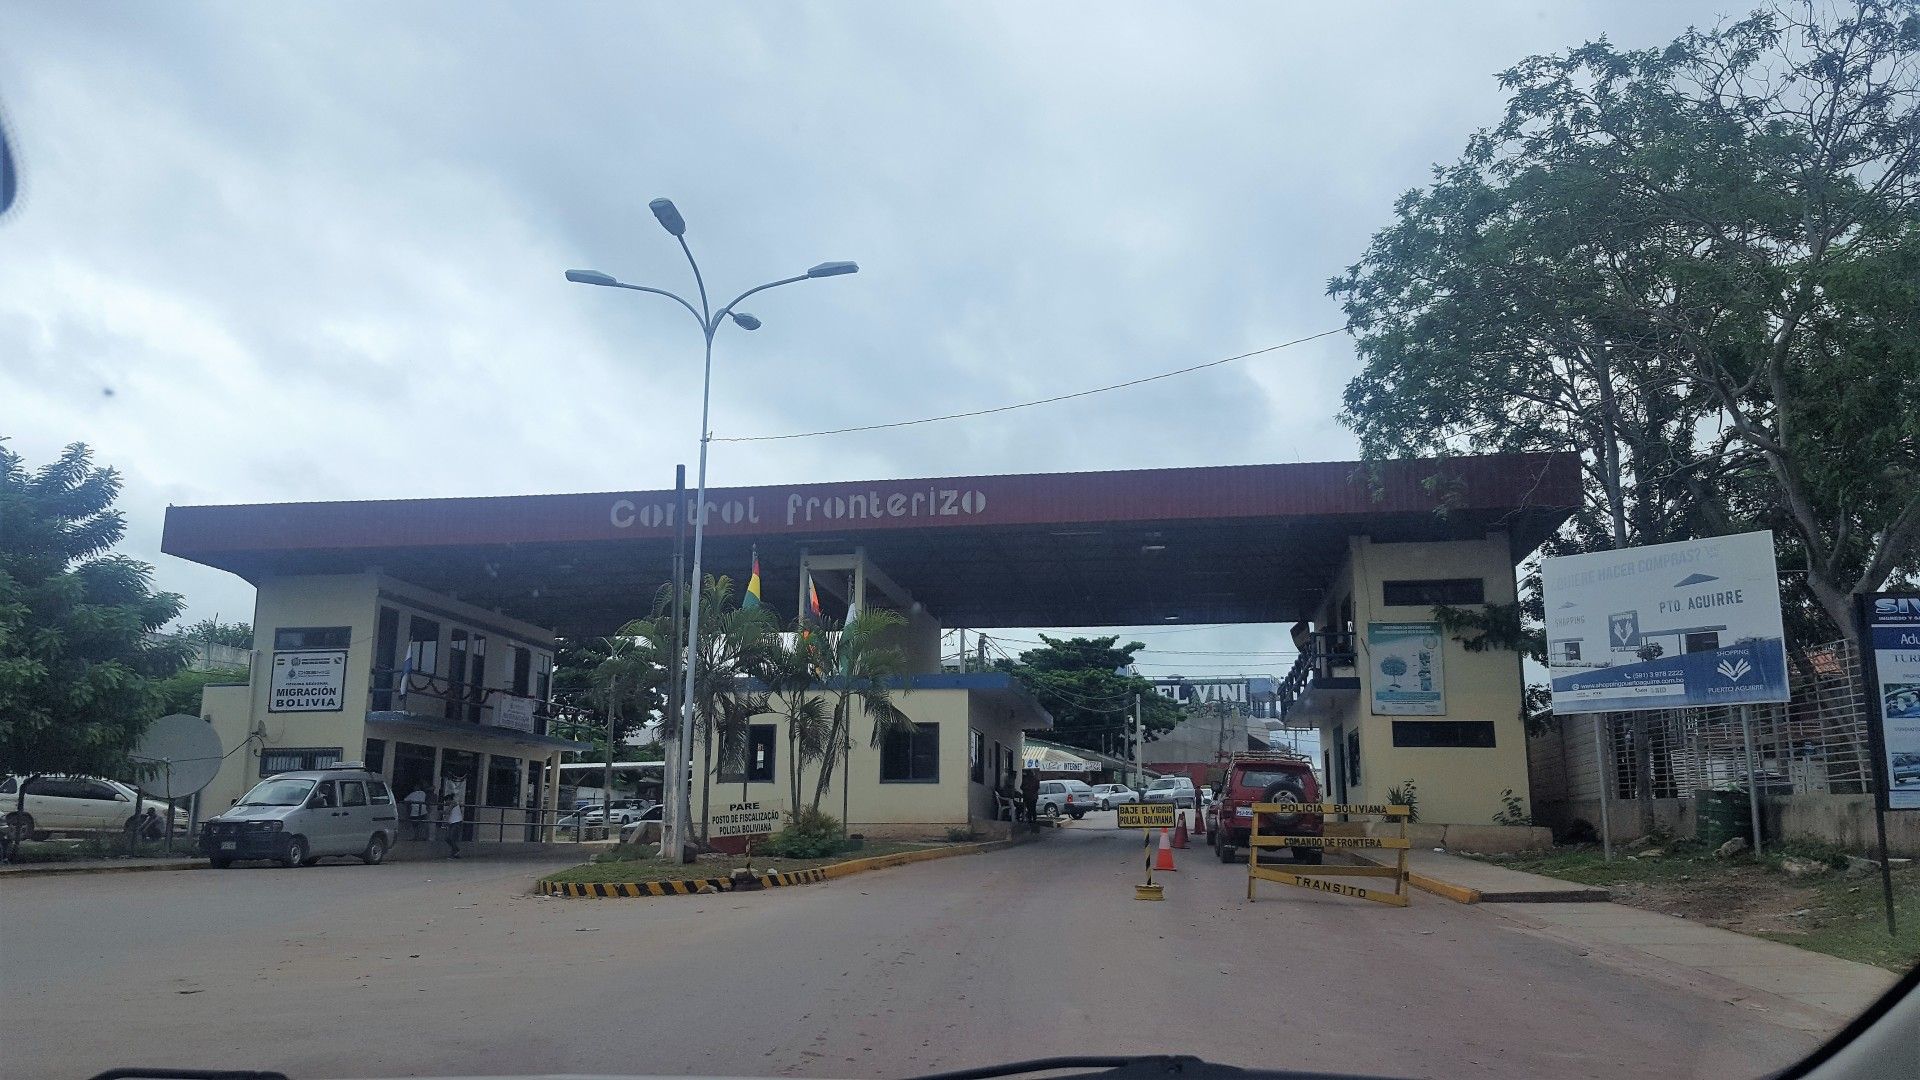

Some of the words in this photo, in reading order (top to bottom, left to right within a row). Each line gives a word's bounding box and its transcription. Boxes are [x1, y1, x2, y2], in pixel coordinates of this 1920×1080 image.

[786, 487, 987, 526] fronterizo
[1597, 562, 1635, 581] HACER
[1638, 547, 1701, 575] COMPRAS?
[1688, 589, 1744, 610] AGUIRRE
[276, 685, 337, 697] MIGRACIÓN
[1708, 686, 1734, 694] PUERTO
[1734, 684, 1764, 692] AGUIRRE
[276, 698, 336, 707] BOLIVIA
[1063, 763, 1083, 771] INTERNET
[729, 802, 760, 811] PARE
[1120, 806, 1139, 814] BAJE
[1141, 806, 1150, 814] EL
[1150, 806, 1173, 814] VIDRIO
[1280, 804, 1324, 813] POLICIA
[1333, 804, 1388, 814] BOLIVIANA
[712, 815, 730, 824] POSTO
[731, 814, 739, 823] DE
[740, 810, 779, 822] FISCALIZAÇÃO
[1120, 816, 1141, 824] POLICIA
[1143, 815, 1173, 824] BOLIVIANA
[742, 823, 772, 833] BOLIVIANA
[1284, 837, 1323, 847] COMANDO
[1324, 838, 1335, 847] DE
[1337, 838, 1382, 848] FRONTERA
[1294, 875, 1367, 898] TRANSITO
